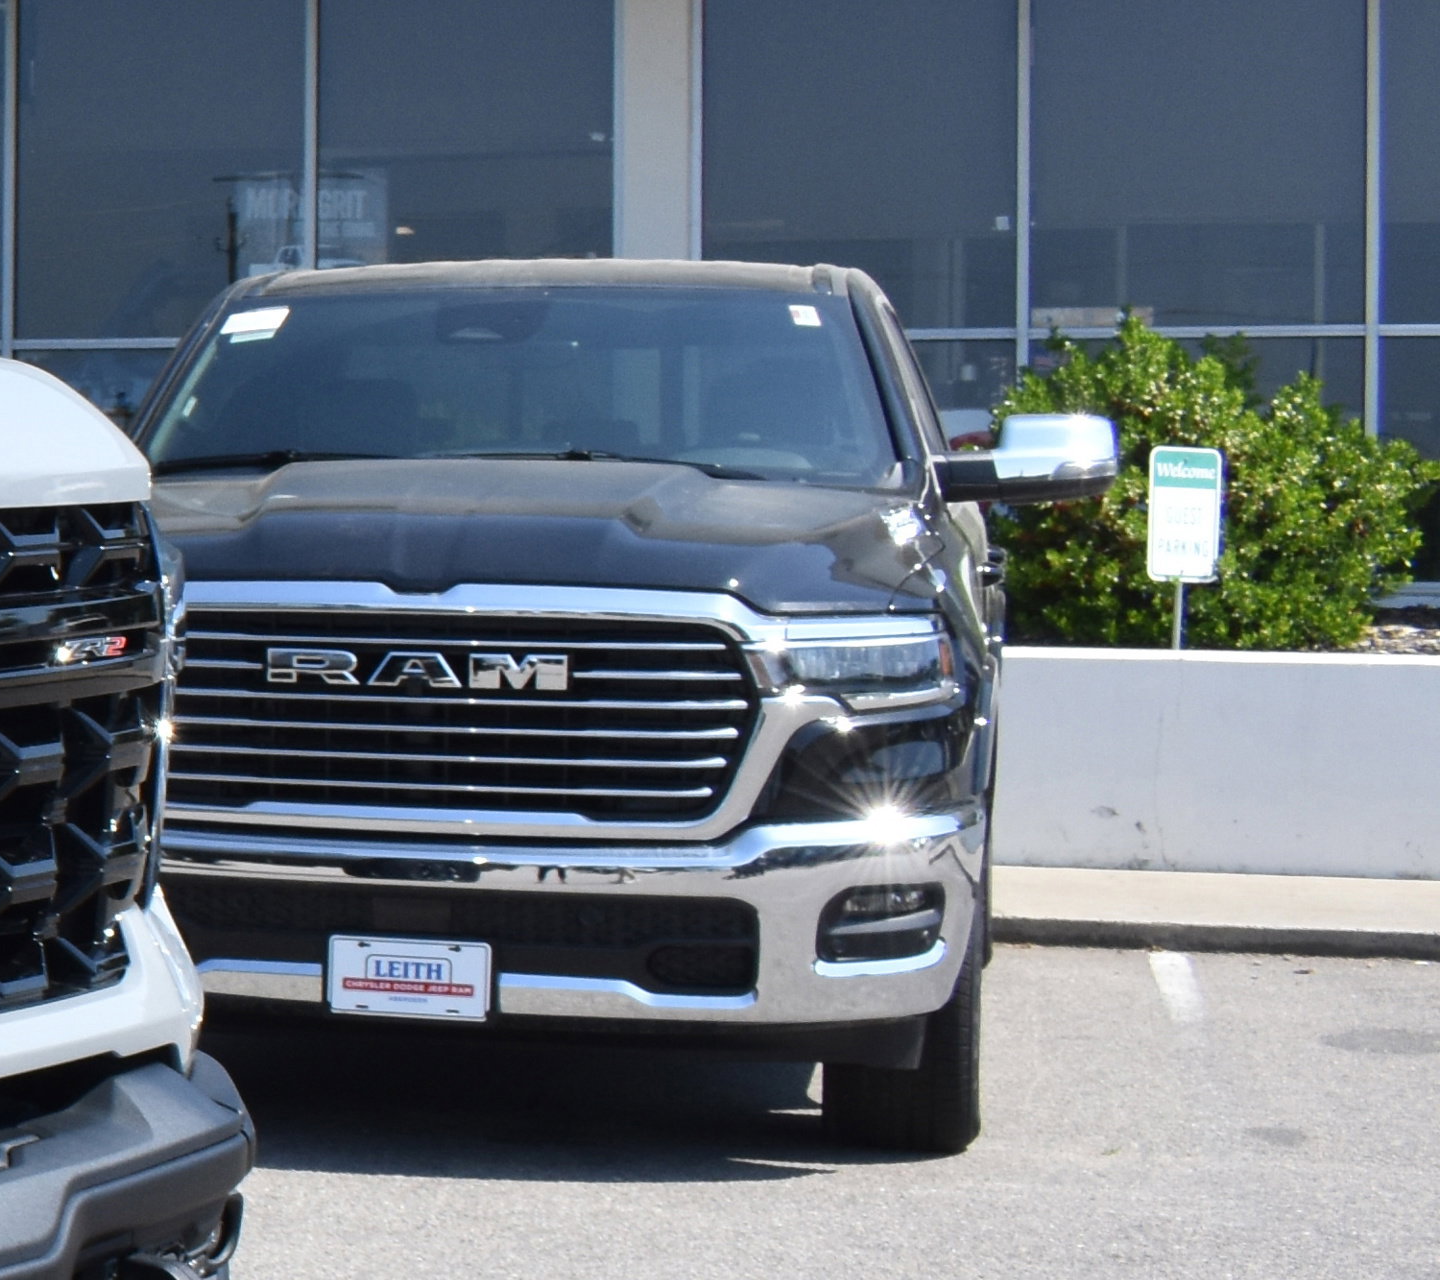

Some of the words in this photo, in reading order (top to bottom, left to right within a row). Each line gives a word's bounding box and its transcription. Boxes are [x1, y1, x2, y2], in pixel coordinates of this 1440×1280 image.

[1156, 461, 1217, 480] Welcome
[1157, 538, 1210, 558] PARKING
[267, 648, 568, 690] RAM
[374, 959, 443, 981] LEITH
[345, 979, 392, 991] CHRYSLER
[393, 982, 426, 992] DODGE
[427, 984, 449, 993] JEEP
[450, 986, 472, 995] RAM
